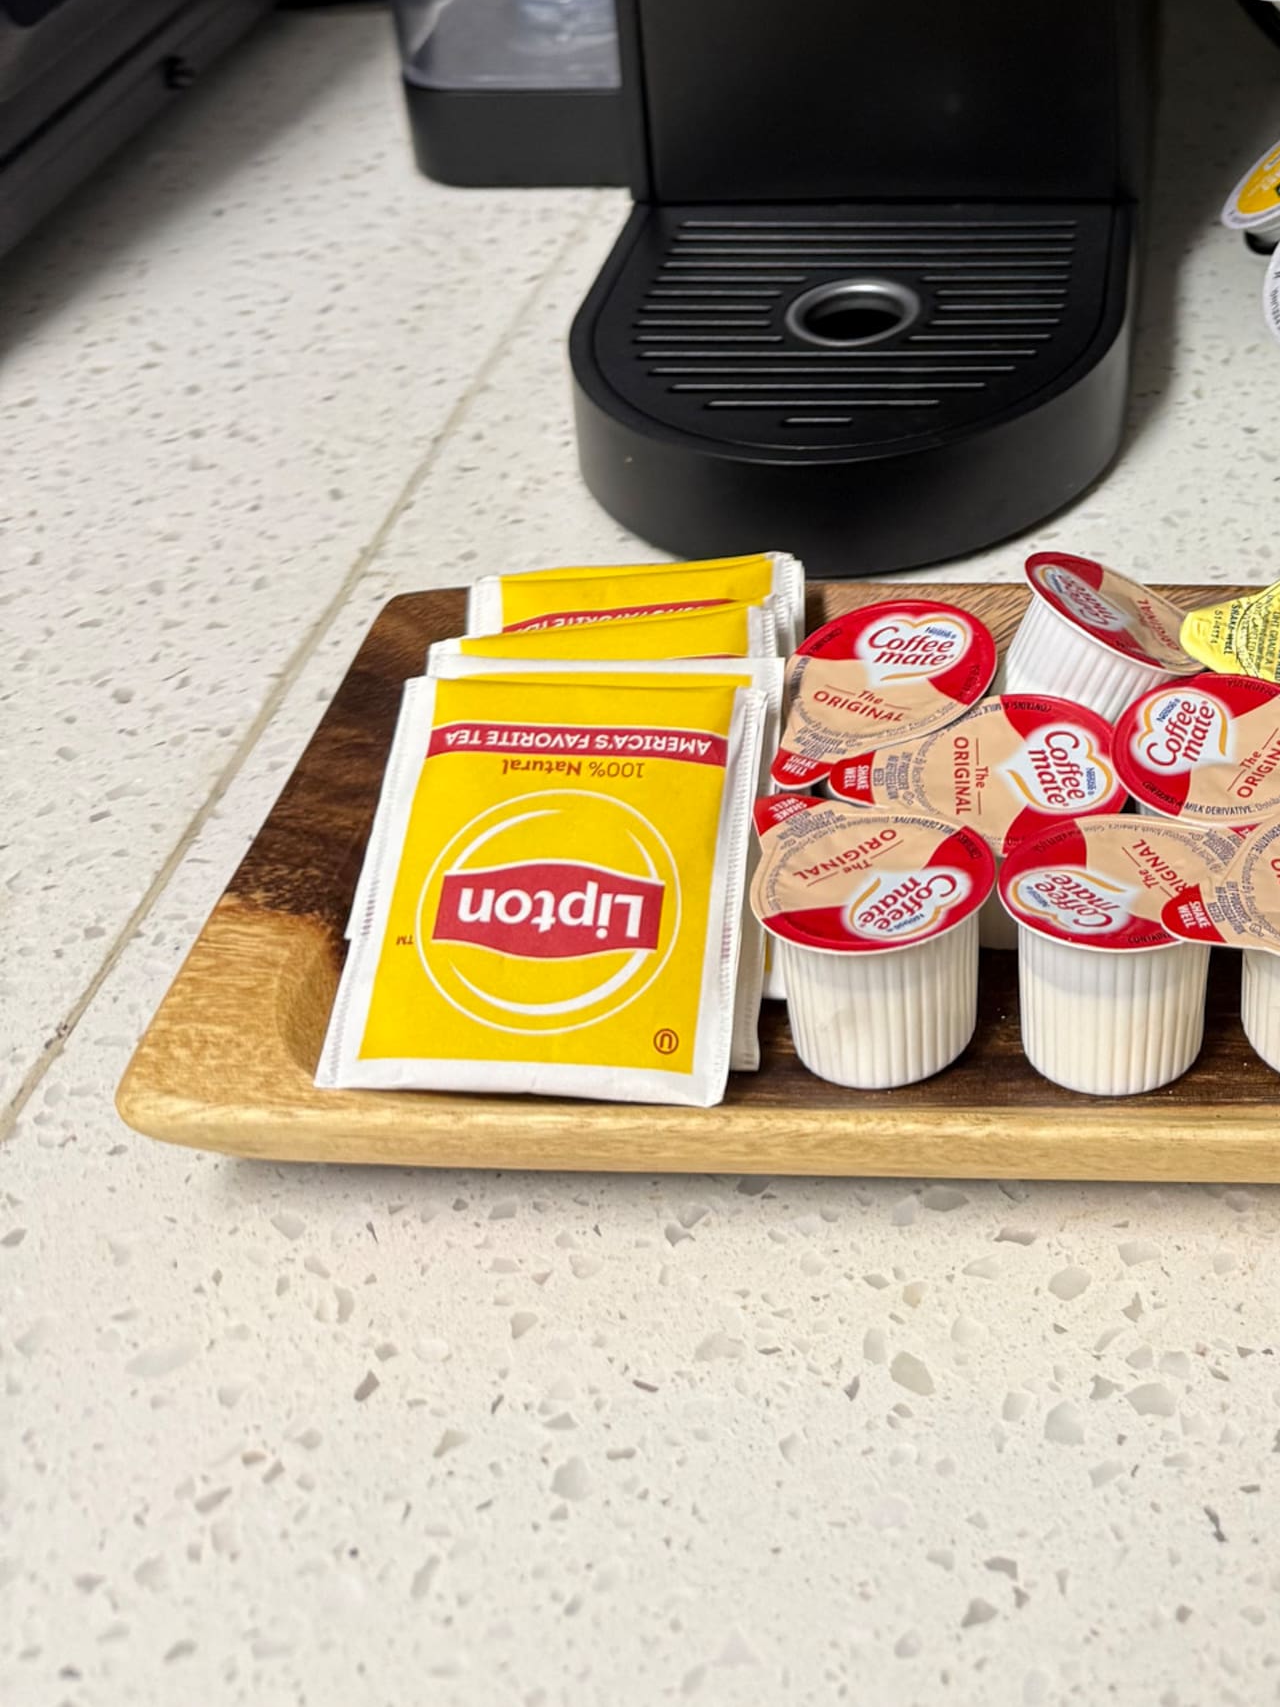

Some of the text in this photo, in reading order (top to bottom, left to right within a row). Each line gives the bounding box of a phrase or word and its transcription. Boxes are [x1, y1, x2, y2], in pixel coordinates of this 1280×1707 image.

[867, 626, 955, 652] Coffee
[873, 649, 947, 667] mate
[813, 689, 905, 723] ORIGINAL
[859, 690, 885, 706] The
[444, 730, 712, 756] AMERICA'S FAVORITE TEA
[1145, 698, 1198, 767] Coffee
[1180, 705, 1216, 763] mate
[500, 758, 645, 779] 100% Natural
[843, 767, 855, 788] WELL
[856, 764, 870, 790] SHAKE
[953, 736, 971, 816] ORIGINAL
[975, 766, 989, 788] The
[1027, 748, 1066, 807] mate
[1043, 730, 1086, 803] Coffee
[1239, 750, 1263, 776] The
[793, 829, 897, 880] ORIGINAL
[841, 858, 873, 875] The
[1051, 873, 1121, 912] mate
[1141, 867, 1160, 890] The
[456, 881, 646, 939] Lipton
[858, 876, 922, 924] mate
[875, 873, 957, 931] Coffee
[1034, 881, 1115, 930] Coffee
[1186, 900, 1212, 931] SHAKE
[1176, 902, 1197, 930] WELL
